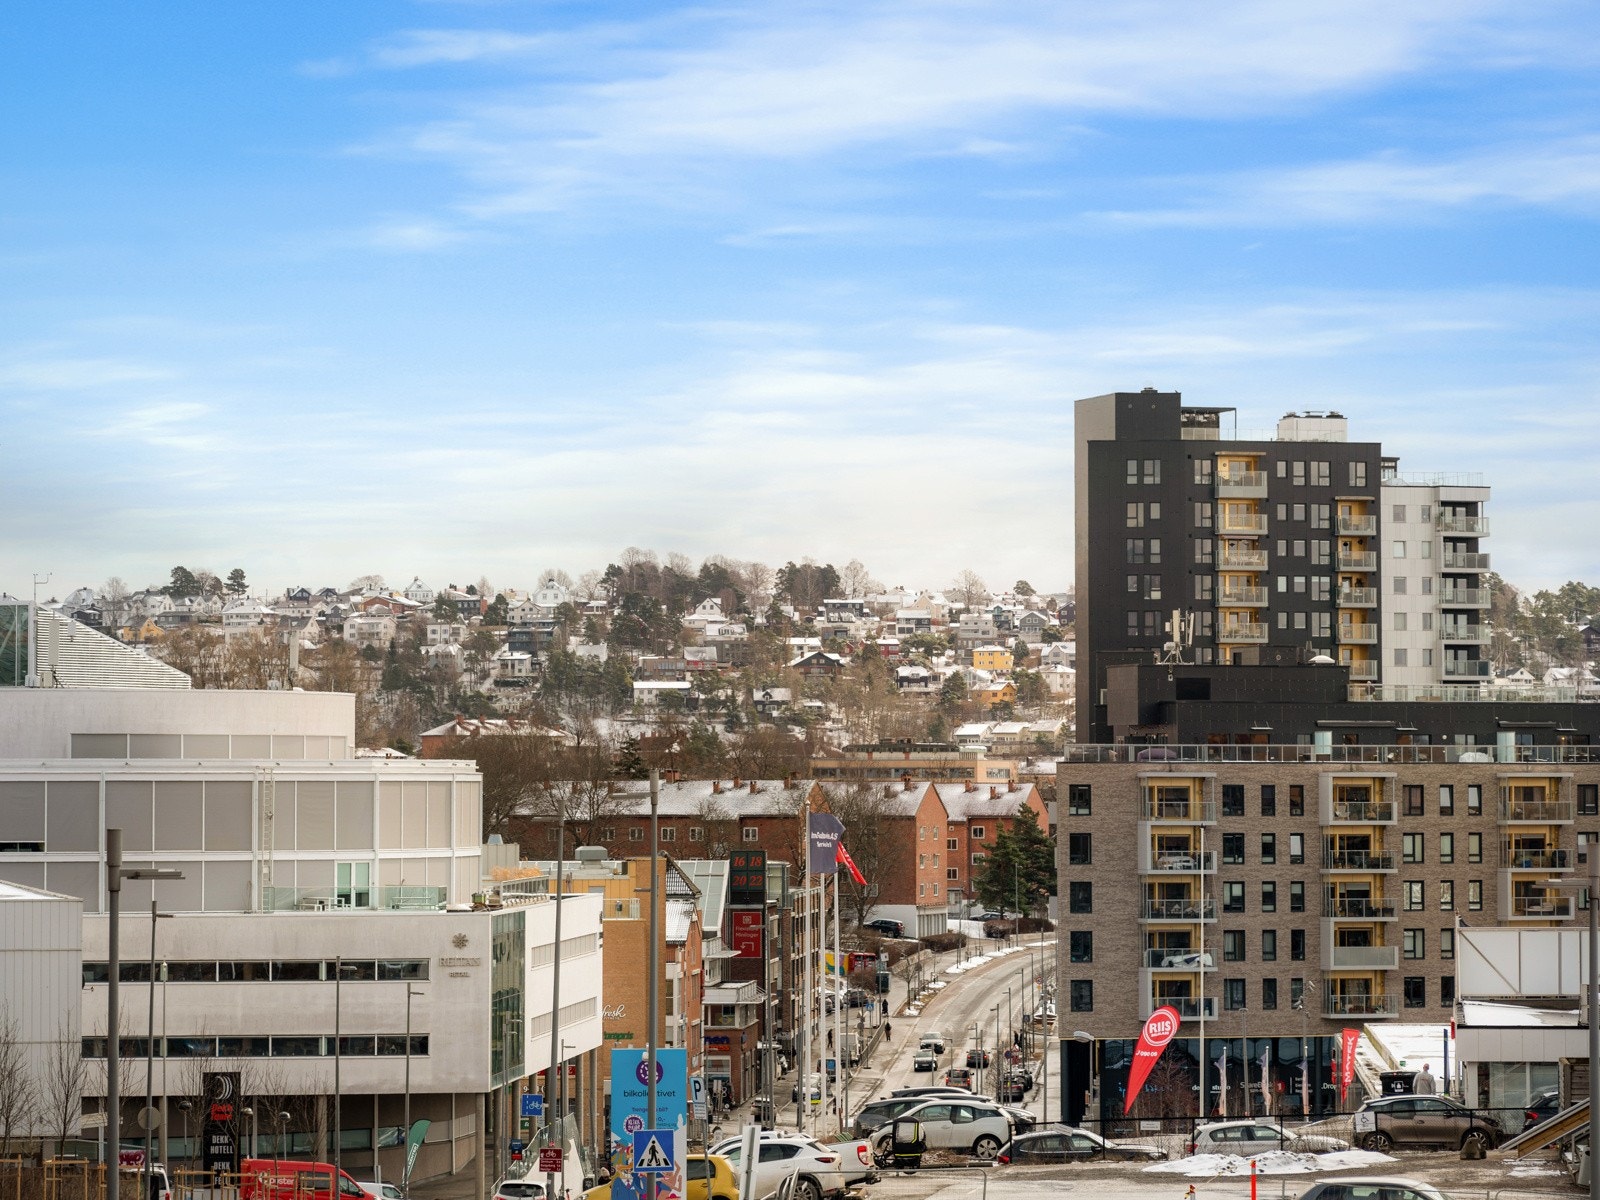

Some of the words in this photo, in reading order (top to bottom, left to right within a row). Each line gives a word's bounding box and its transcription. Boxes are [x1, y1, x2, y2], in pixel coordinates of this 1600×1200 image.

[733, 857, 745, 867] 16
[749, 857, 762, 867] 18
[732, 876, 746, 887] 20
[749, 876, 763, 887] 22
[1149, 1021, 1171, 1035] RIIS
[623, 1089, 676, 1098] bilkolletivet
[694, 1080, 702, 1100] P
[210, 1145, 234, 1154] HOTELL
